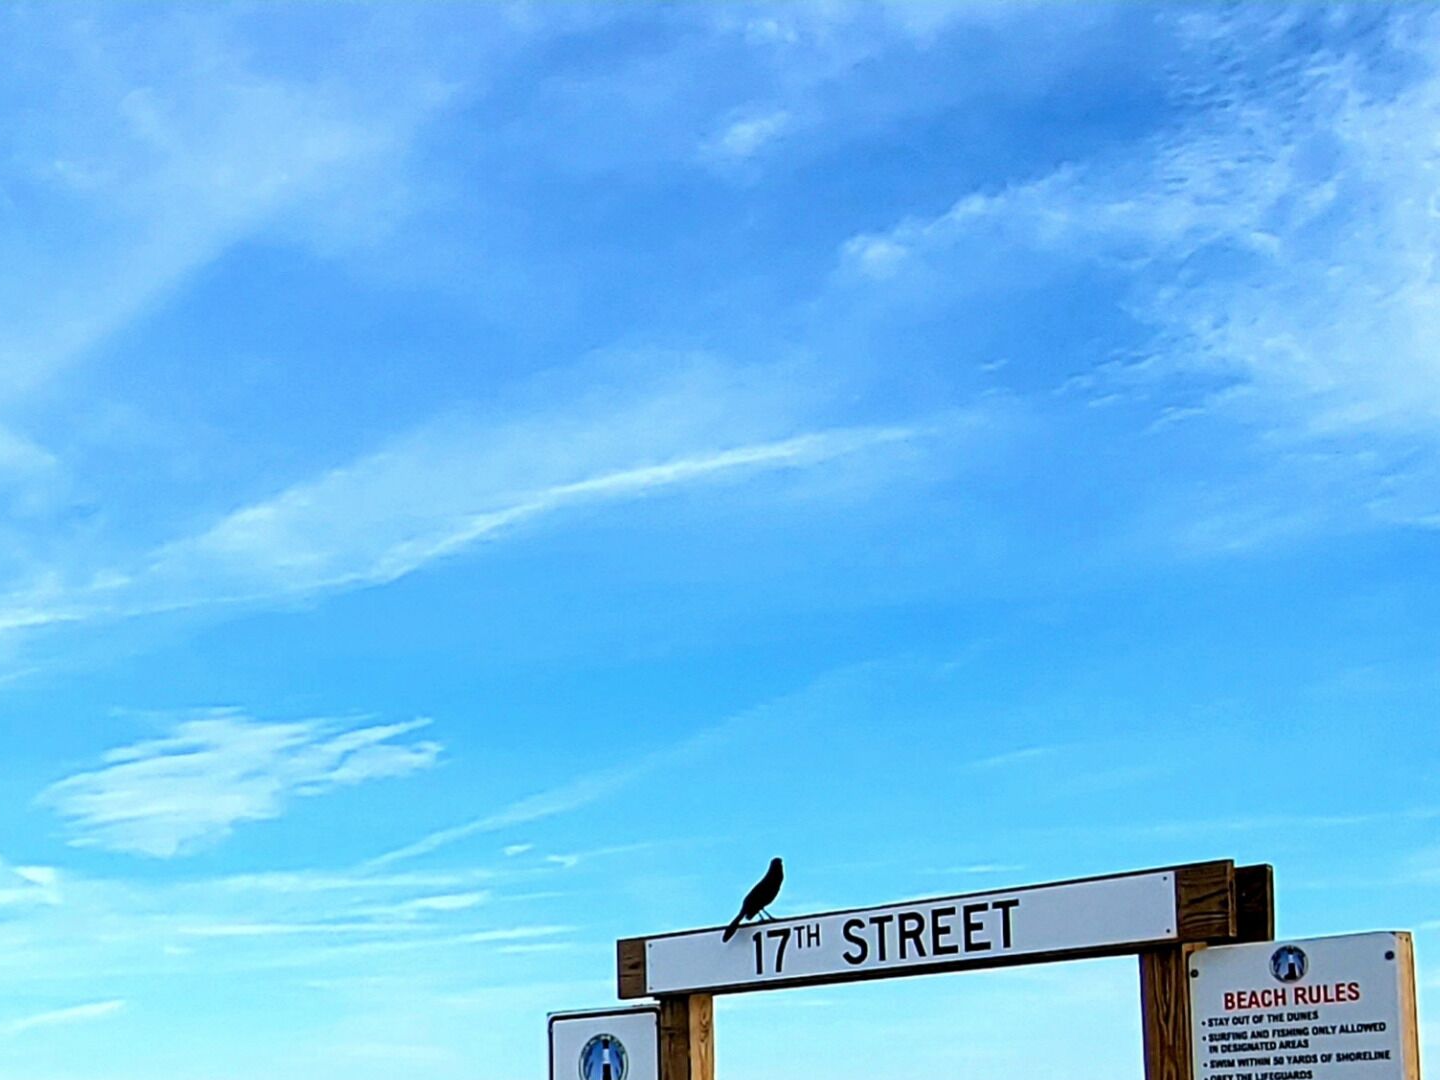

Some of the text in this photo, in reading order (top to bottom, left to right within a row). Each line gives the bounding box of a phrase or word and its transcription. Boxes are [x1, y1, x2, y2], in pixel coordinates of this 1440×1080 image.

[751, 898, 1021, 975] 17TH STREET
[1224, 982, 1361, 1010] BEACH RULES
[1208, 1011, 1319, 1027] STAY OUT OF THE DUNES
[1208, 1022, 1387, 1042] SURFING AND FISHING ONLY ALLOWED
[1220, 1041, 1277, 1053] DESIGNATED
[1278, 1039, 1309, 1050] AREAS
[1210, 1059, 1235, 1069] SWIM
[1237, 1057, 1271, 1067] WITHIN
[1286, 1054, 1318, 1064] YARDS
[1320, 1053, 1334, 1062] OF
[1336, 1050, 1391, 1062] SHORELINE
